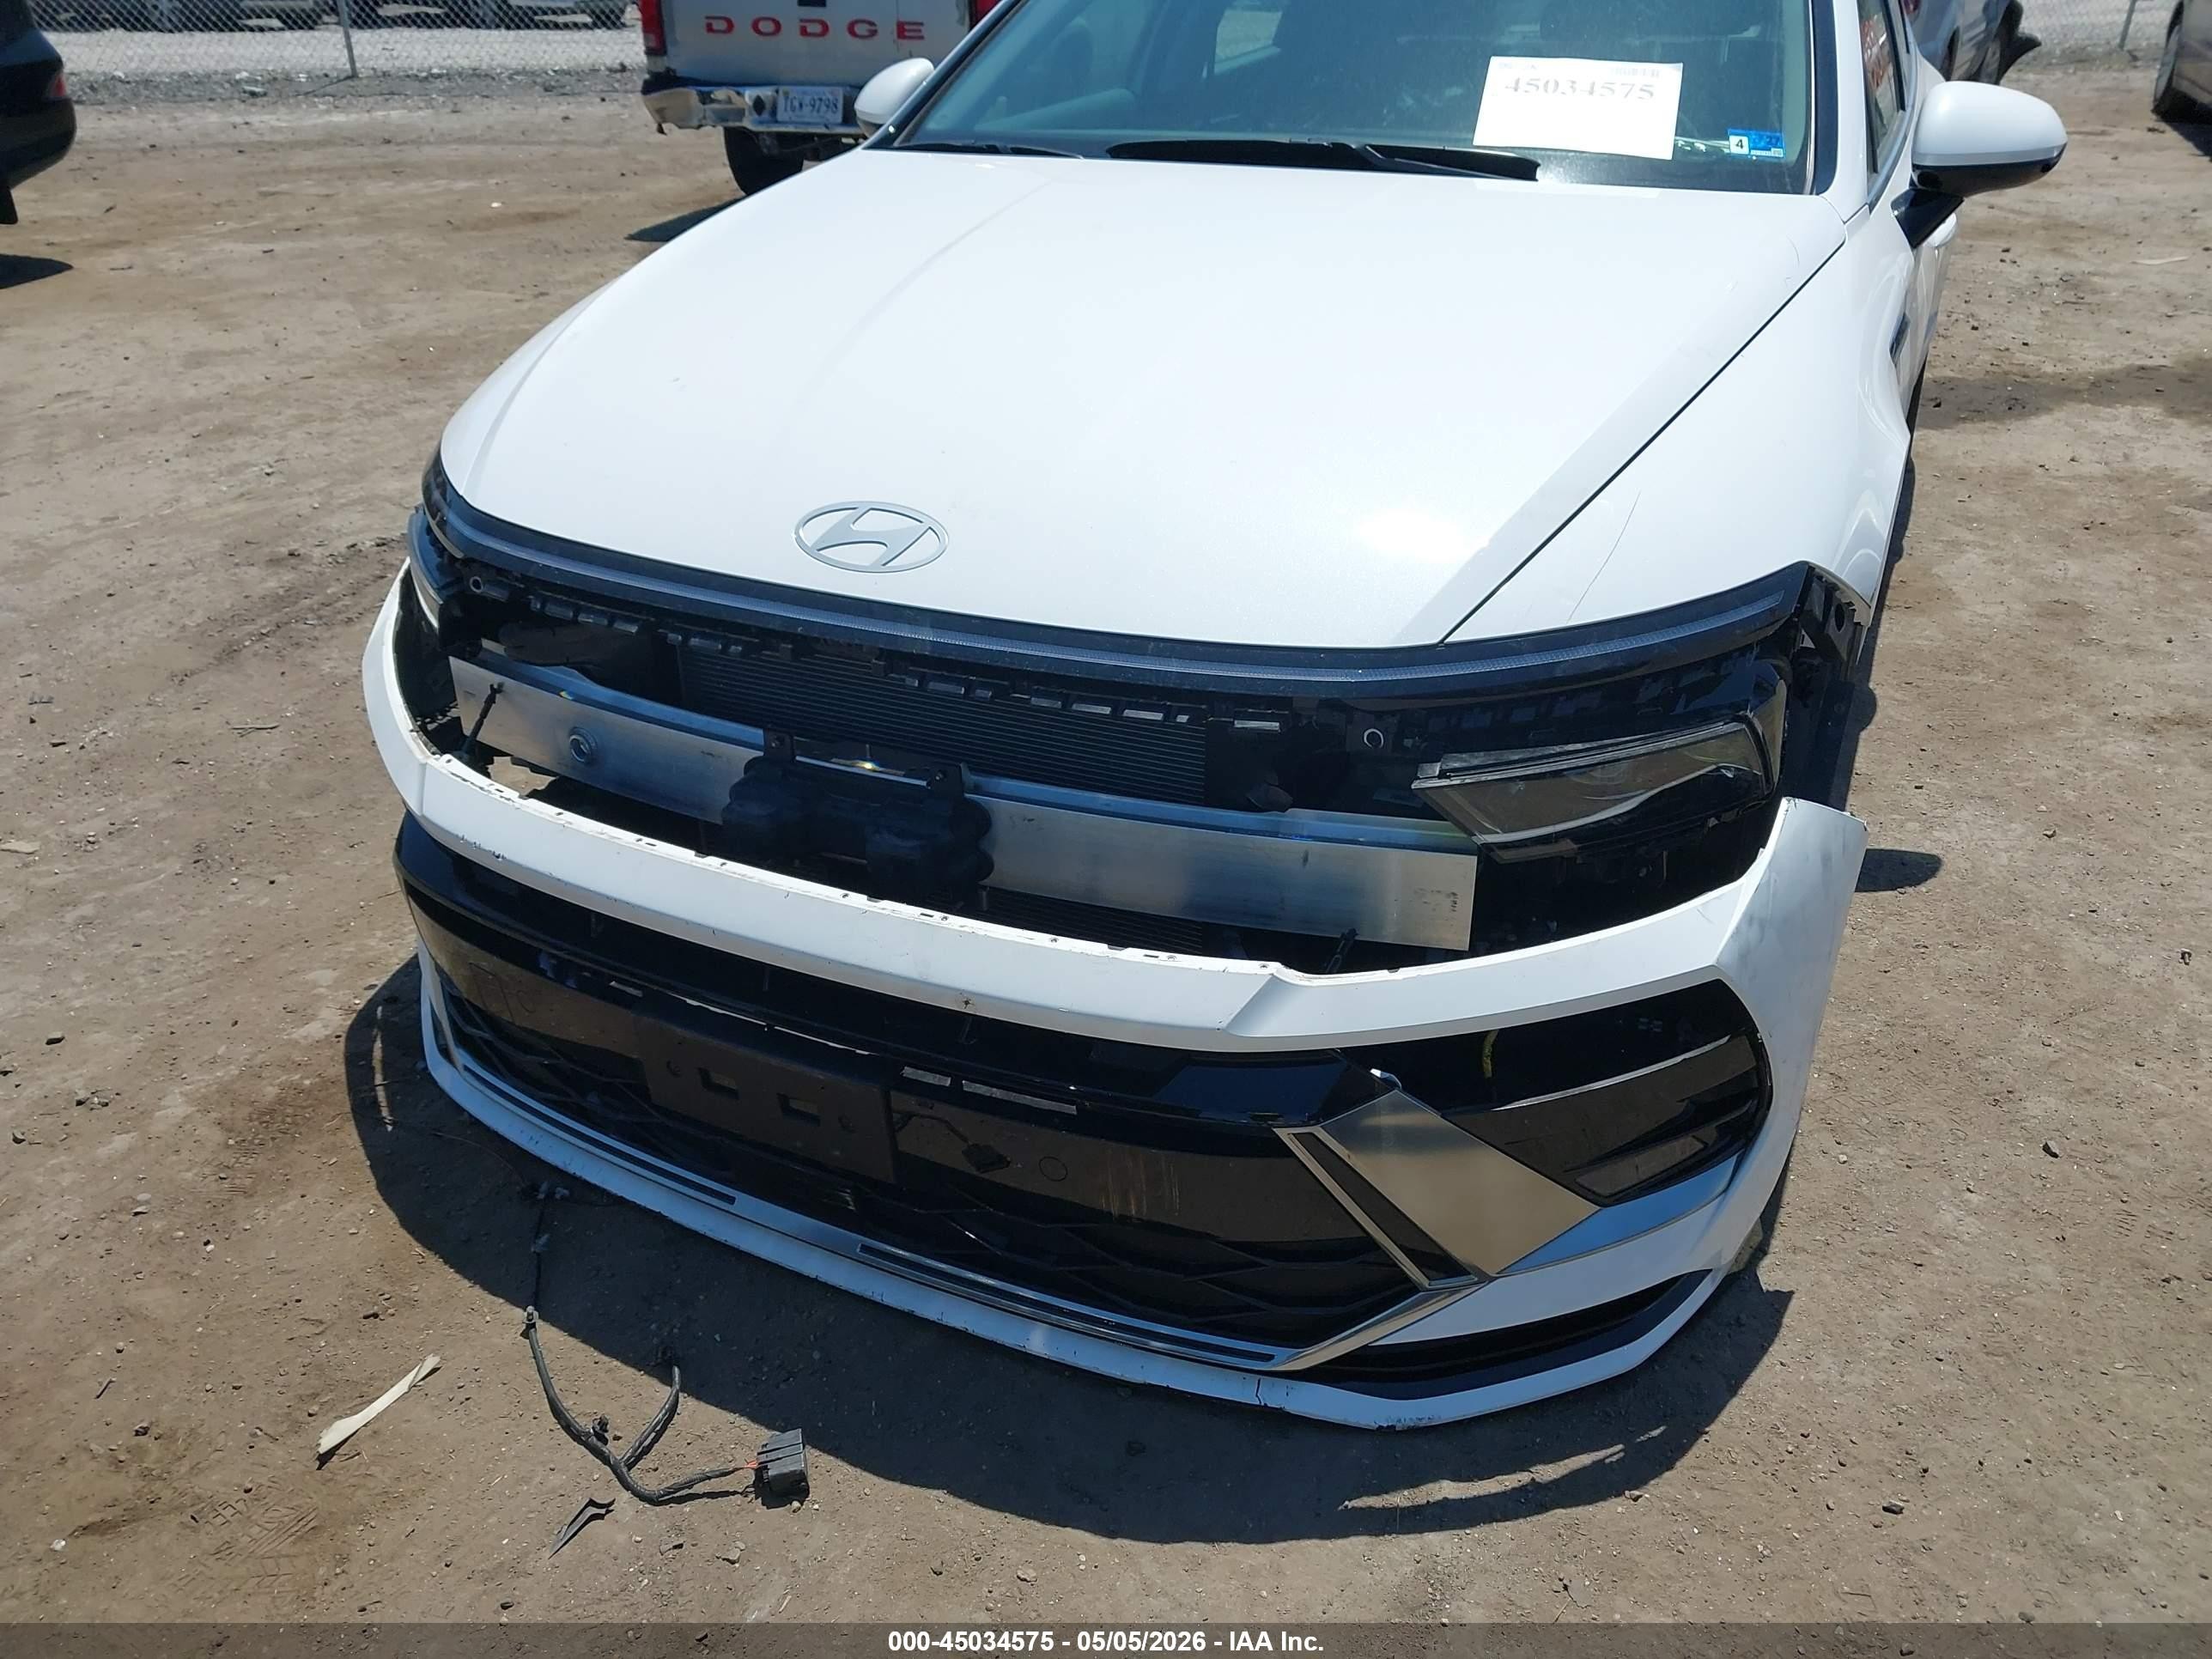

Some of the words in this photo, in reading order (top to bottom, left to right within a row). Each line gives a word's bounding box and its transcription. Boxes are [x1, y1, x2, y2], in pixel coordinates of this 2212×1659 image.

[704, 15, 926, 40] DODGE
[1504, 77, 1656, 100] 45034575
[1735, 138, 1744, 149] 4
